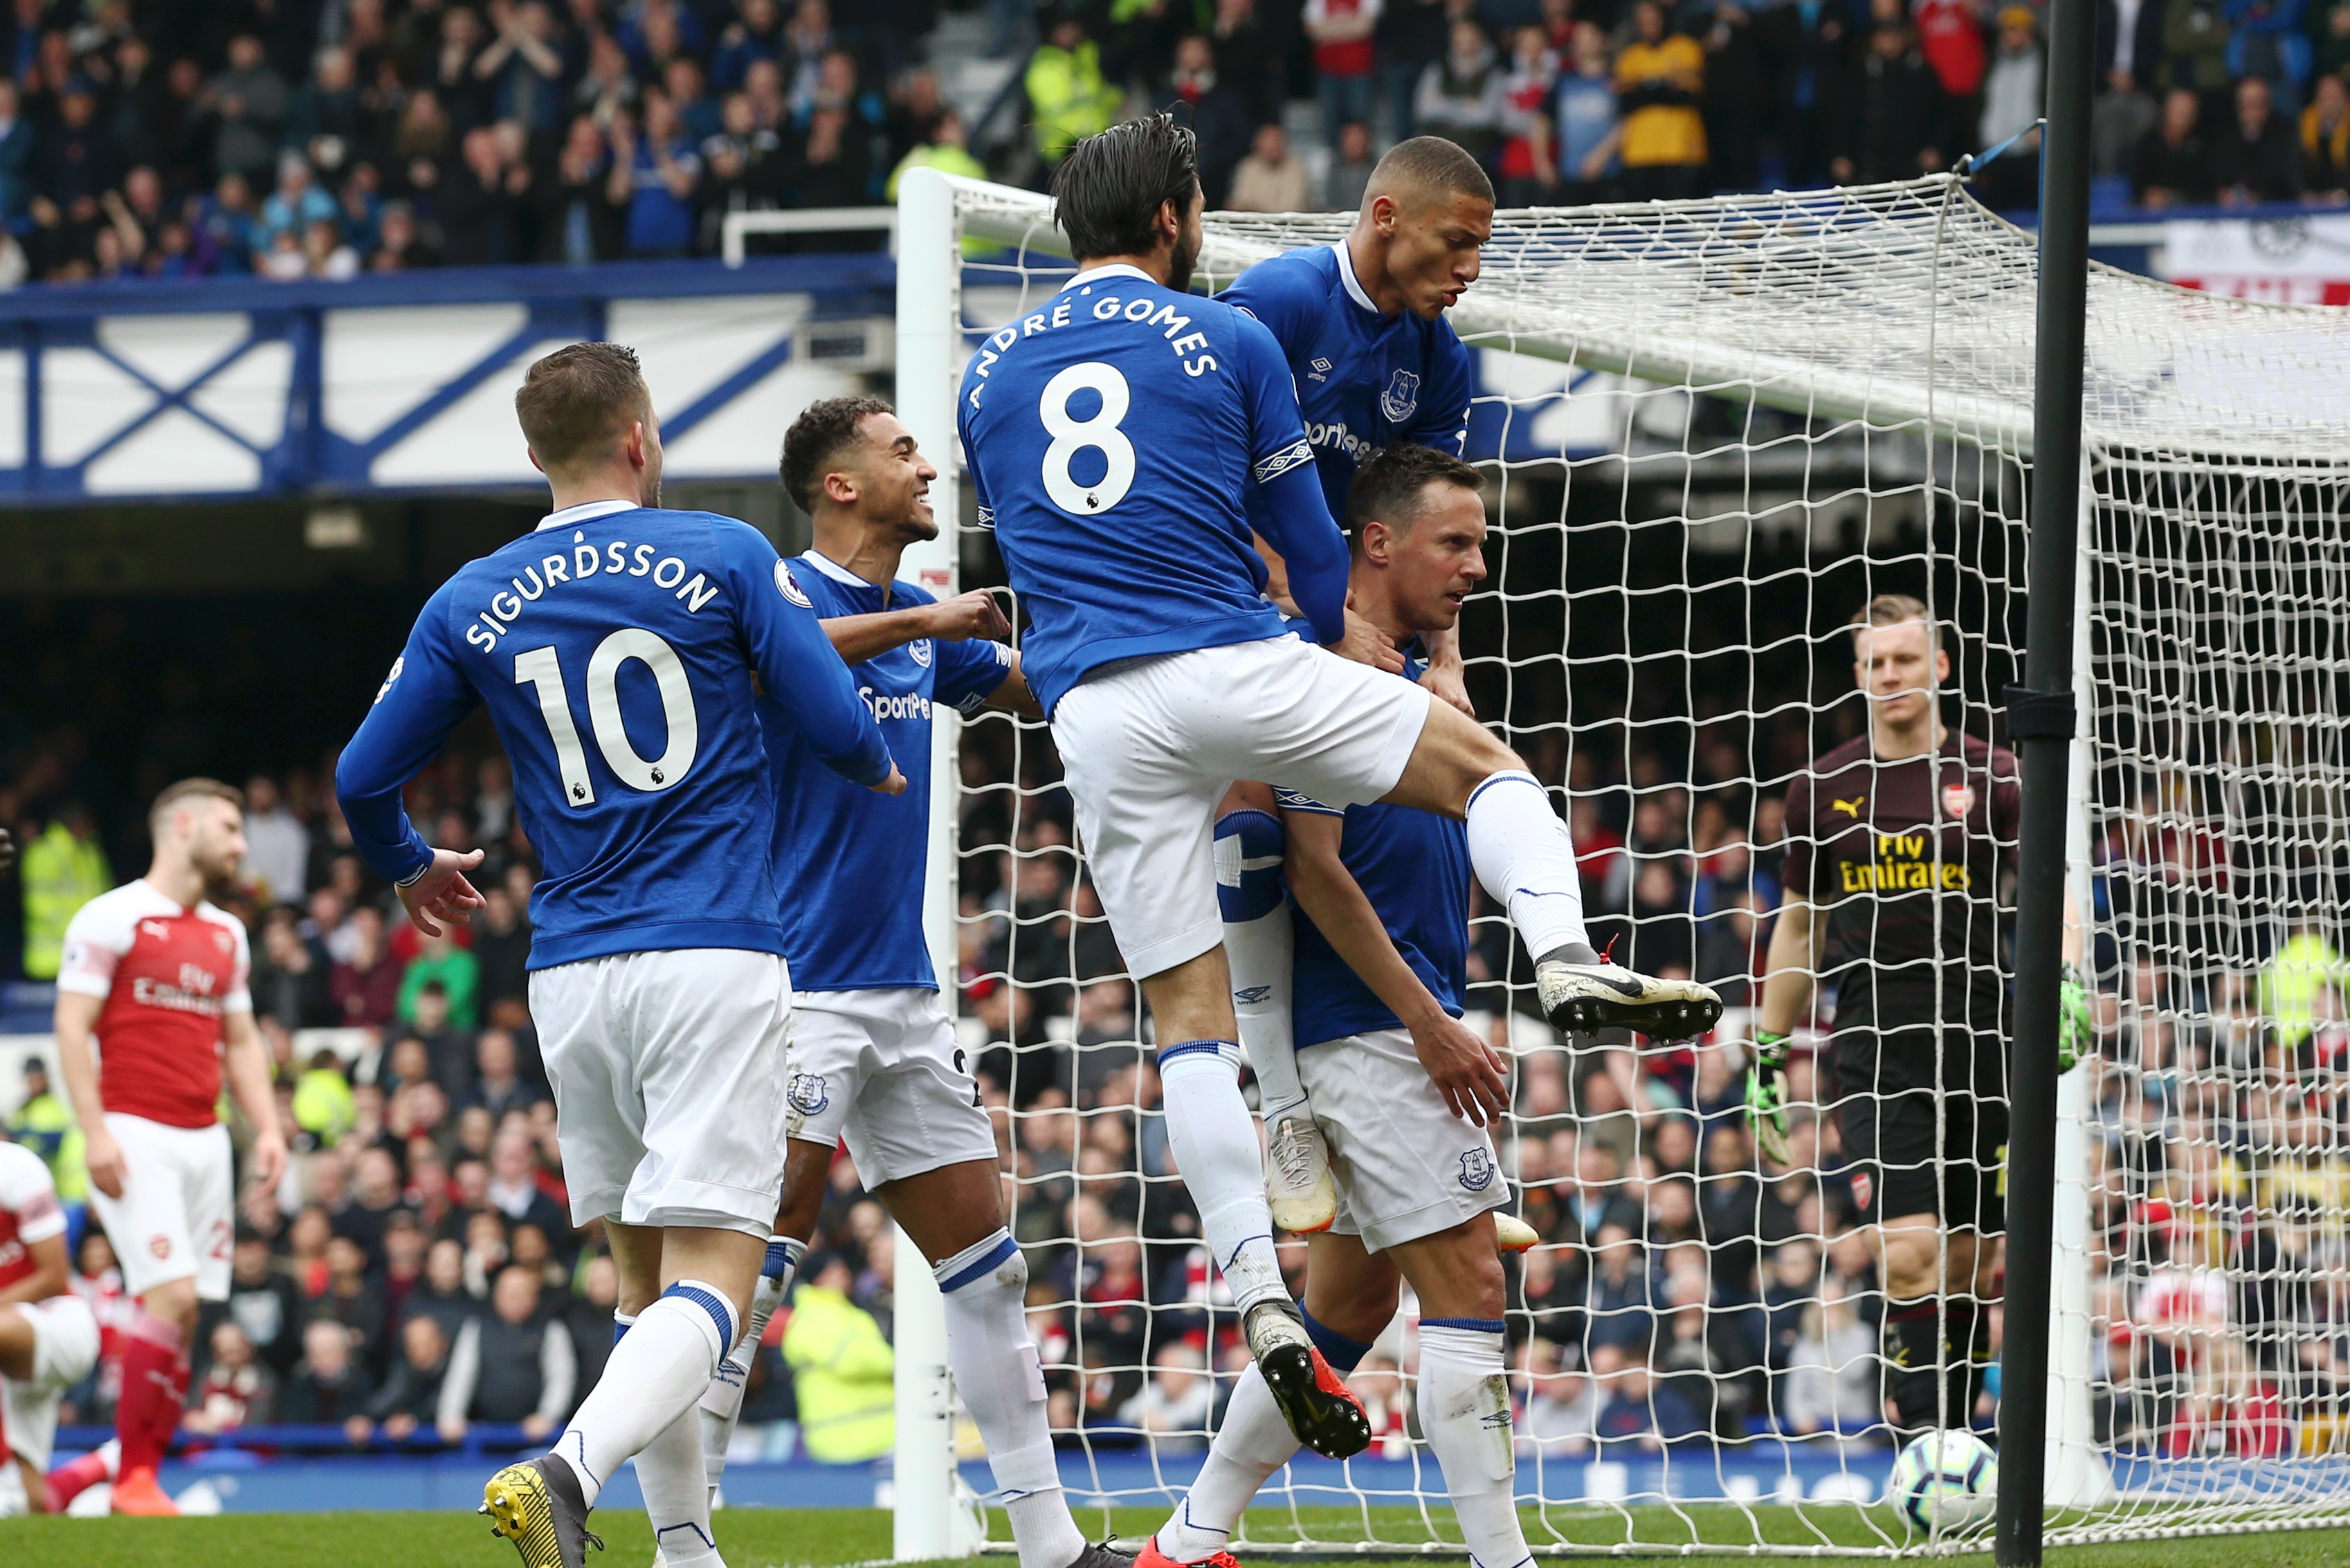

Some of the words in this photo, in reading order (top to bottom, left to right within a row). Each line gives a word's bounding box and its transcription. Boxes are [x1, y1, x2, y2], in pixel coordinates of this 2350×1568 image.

[969, 295, 1073, 410] ANDRÉ
[1093, 296, 1218, 378] GOMES
[1039, 361, 1137, 516] 8
[465, 530, 720, 654] SIGURDSSON
[514, 627, 698, 808] 10
[1839, 855, 1972, 893] Emirates
[1877, 834, 1925, 860] Fly
